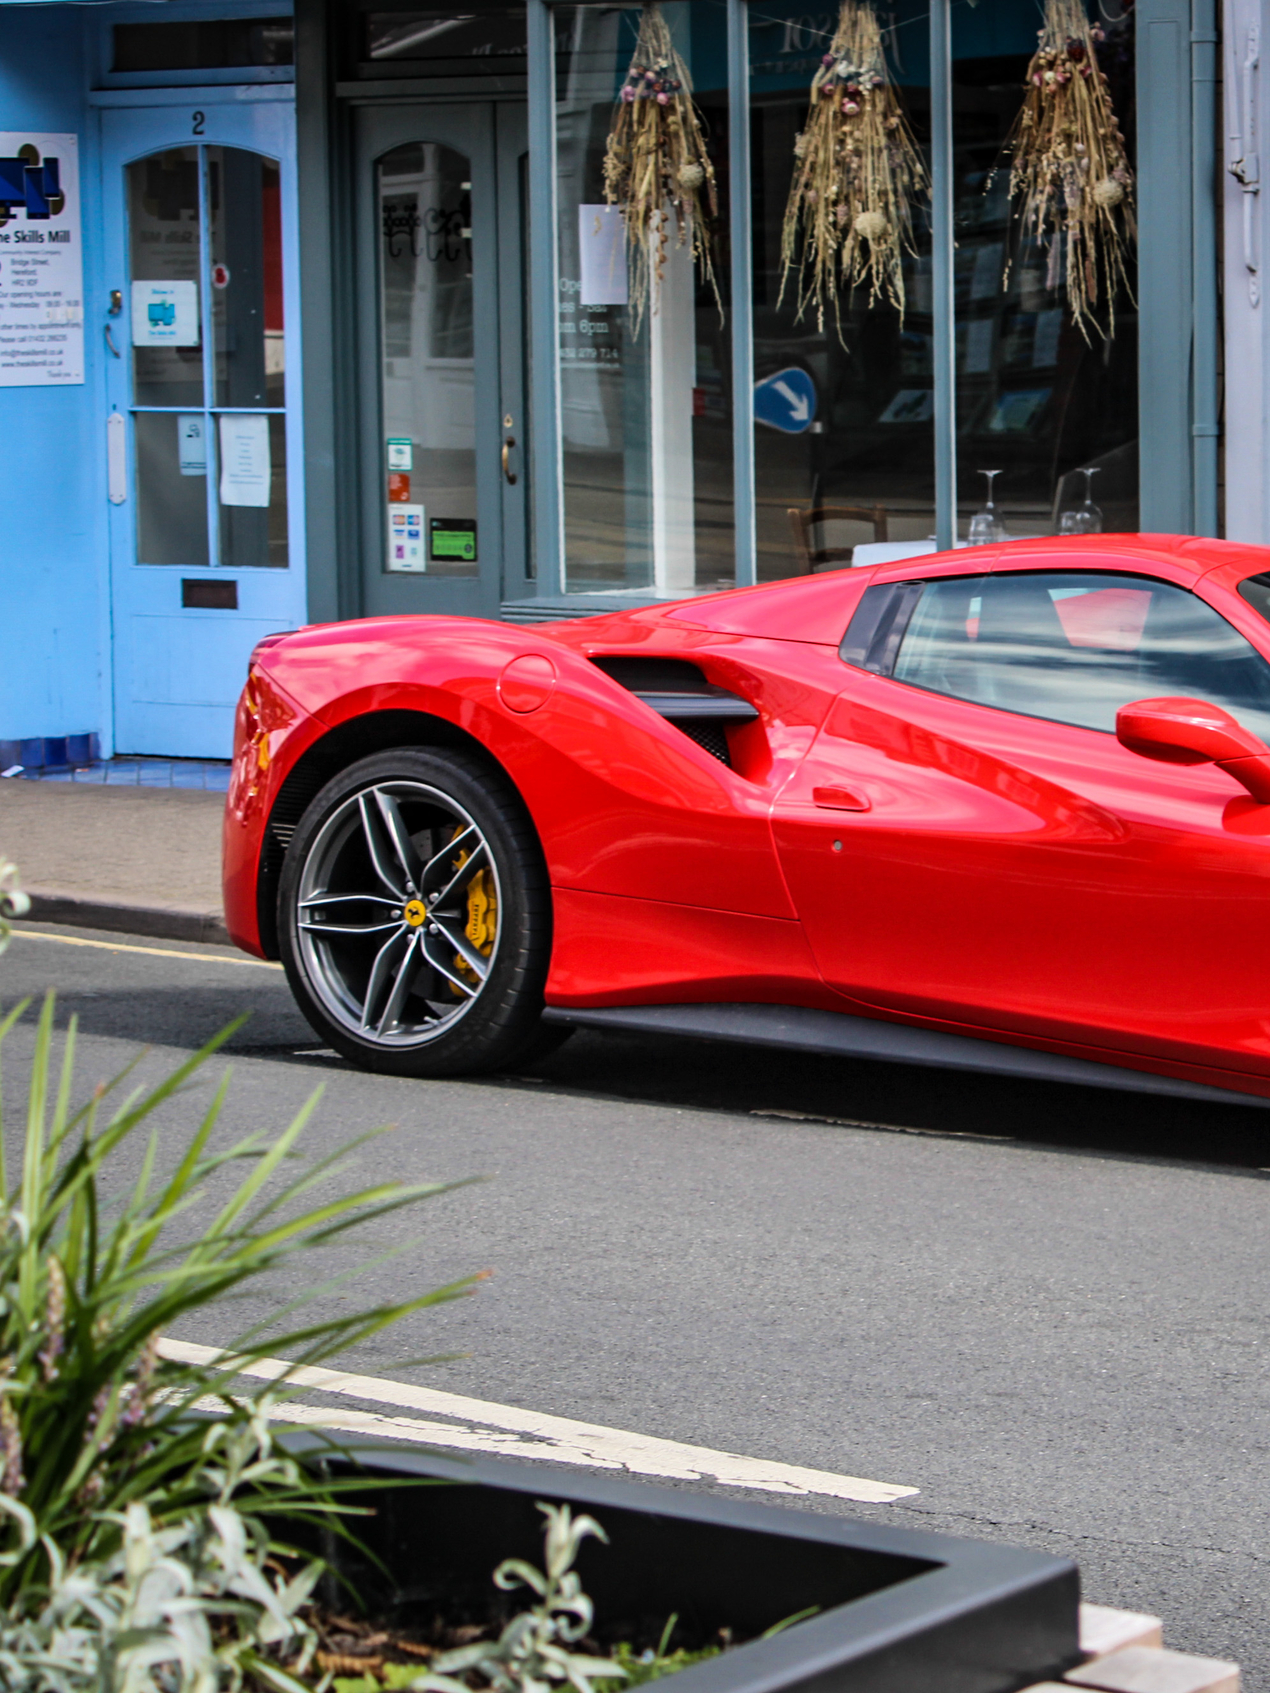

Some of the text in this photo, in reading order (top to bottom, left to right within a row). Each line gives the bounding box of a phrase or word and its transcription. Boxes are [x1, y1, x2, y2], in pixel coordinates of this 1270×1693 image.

[192, 110, 205, 135] 2
[14, 229, 44, 243] Skills
[48, 230, 70, 243] Mill
[579, 319, 610, 336] 6pm
